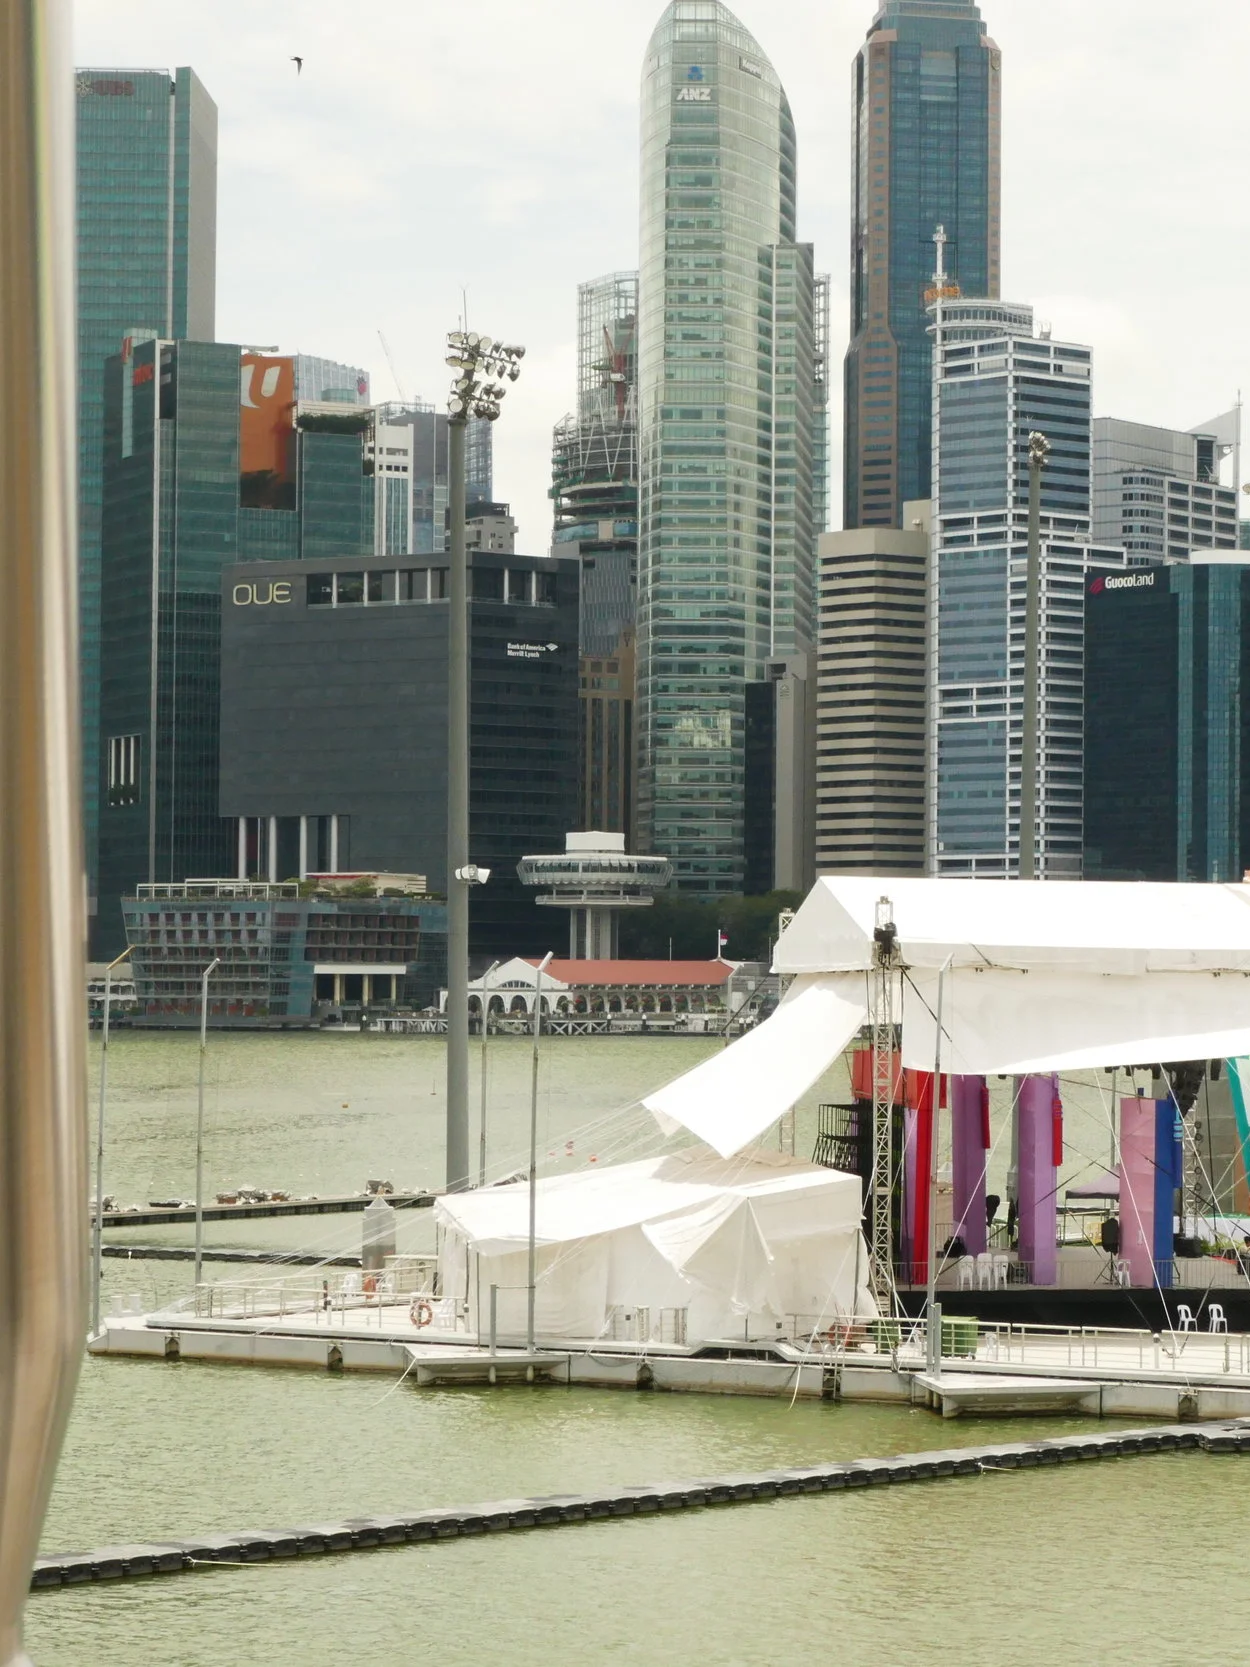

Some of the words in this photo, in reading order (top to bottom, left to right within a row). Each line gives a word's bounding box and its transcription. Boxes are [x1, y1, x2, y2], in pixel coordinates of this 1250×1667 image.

[676, 87, 712, 101] ANZ
[1105, 572, 1155, 589] GuocoLand
[233, 582, 292, 606] OUE
